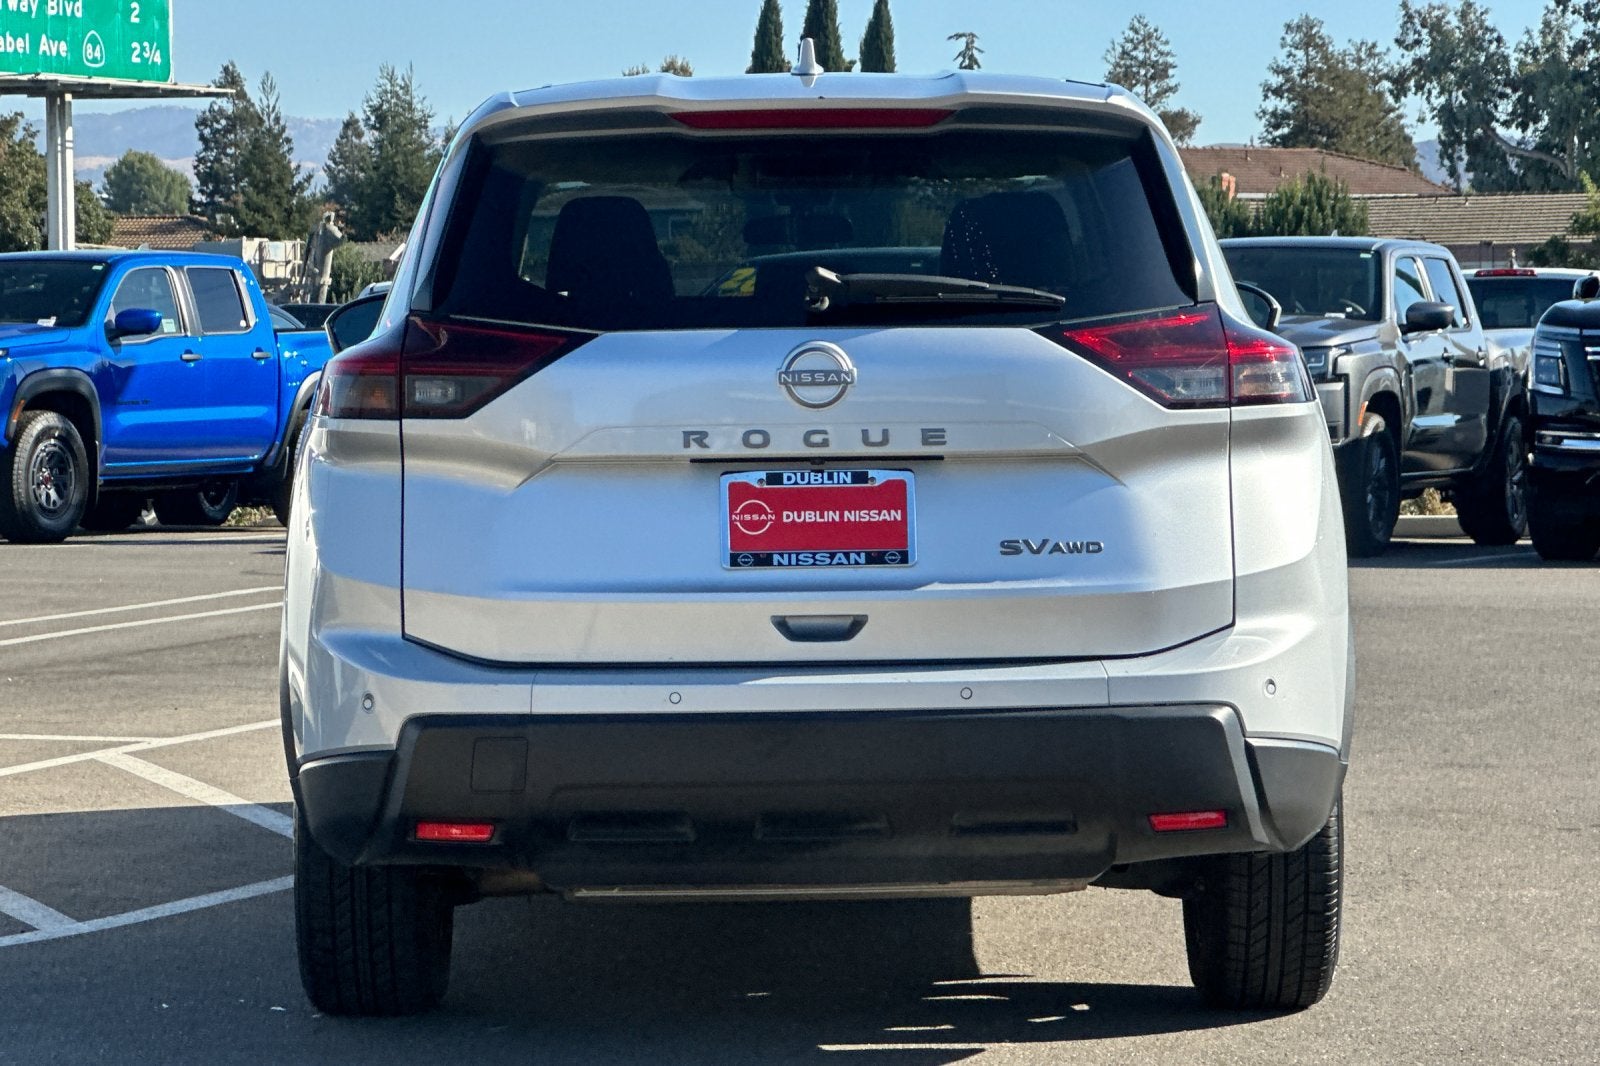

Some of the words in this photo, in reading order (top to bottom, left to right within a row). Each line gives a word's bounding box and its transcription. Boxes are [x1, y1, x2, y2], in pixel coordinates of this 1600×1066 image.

[47, 0, 83, 18] Blvd
[130, 2, 140, 23] 2
[39, 34, 67, 57] Ave
[86, 43, 101, 60] 84
[781, 372, 852, 383] NISSAN
[682, 428, 948, 449] ROGUE
[782, 472, 852, 485] DUBLIN
[782, 510, 840, 523] DUBLIN
[843, 509, 902, 522] NISSAN
[772, 552, 866, 566] NISSAN
